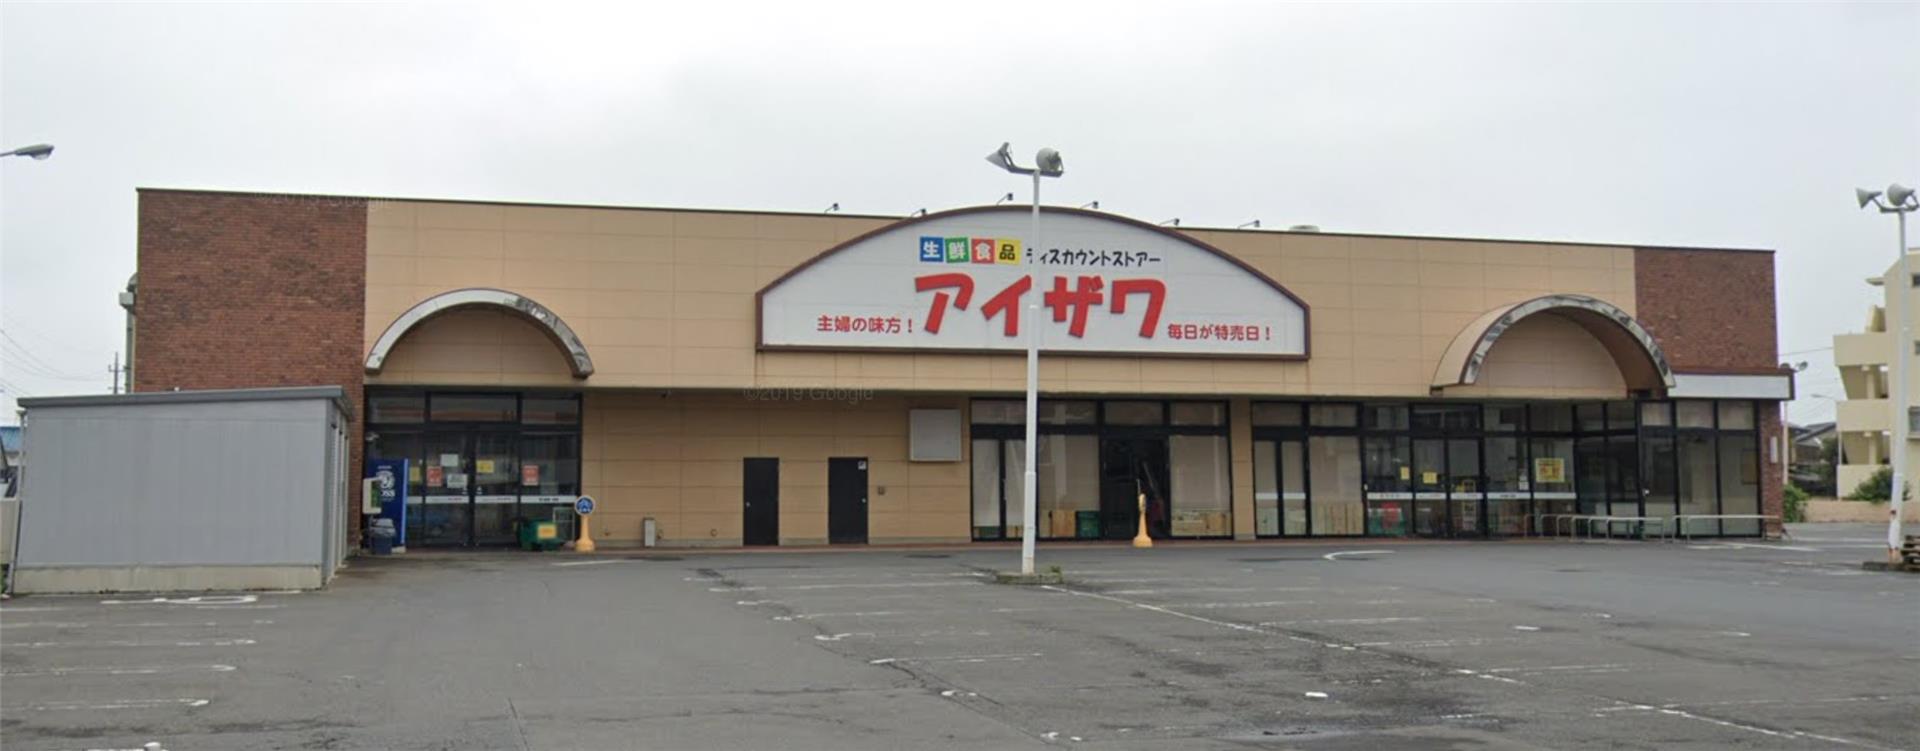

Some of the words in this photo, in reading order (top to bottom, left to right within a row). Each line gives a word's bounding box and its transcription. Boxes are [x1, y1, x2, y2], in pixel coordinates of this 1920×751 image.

[921, 238, 1018, 263] 生鮮食品
[914, 272, 1167, 339] アイザワ
[817, 314, 913, 334] 主婦の味方！
[1167, 323, 1271, 341] 毎日が特売日！
